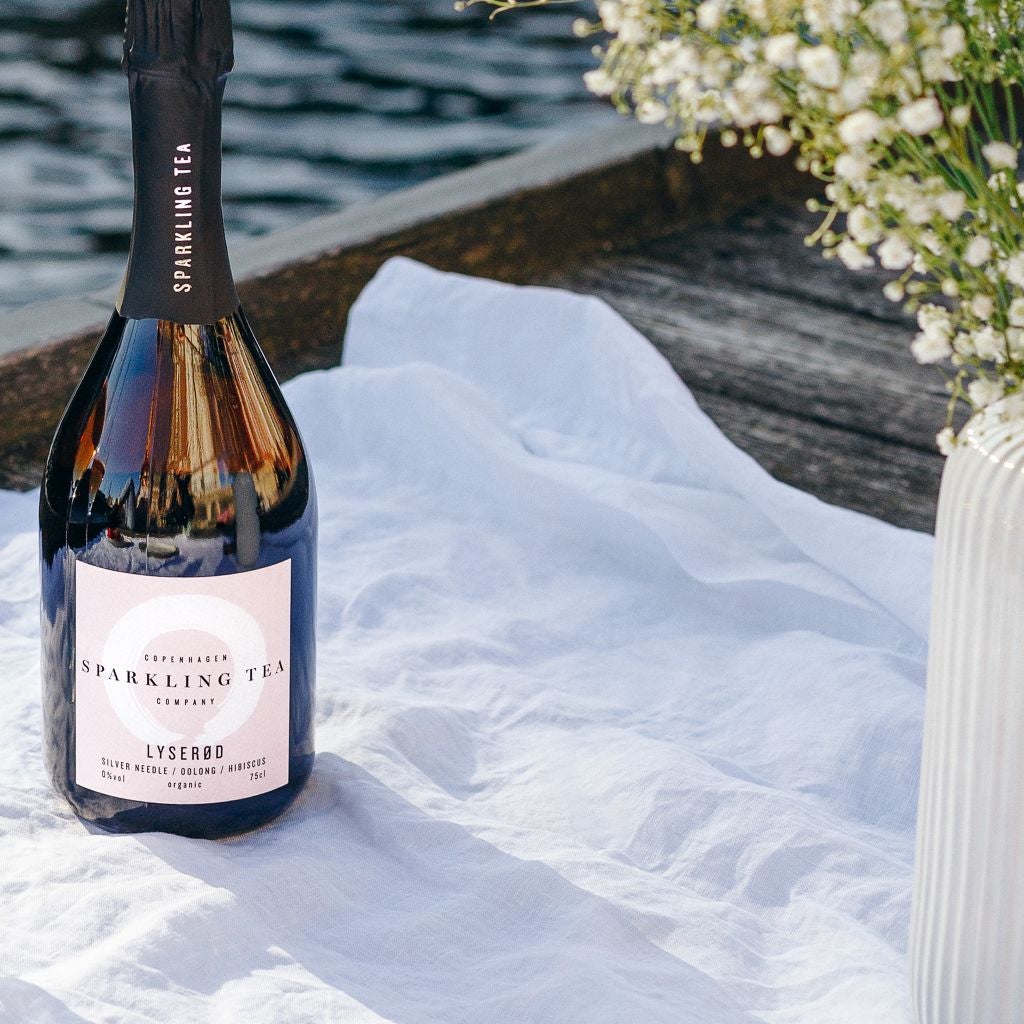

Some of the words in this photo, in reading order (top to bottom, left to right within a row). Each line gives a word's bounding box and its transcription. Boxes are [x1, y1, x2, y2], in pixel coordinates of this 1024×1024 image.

[173, 143, 192, 177] TEA
[173, 186, 192, 293] SPARKLING
[144, 654, 228, 663] COPENHAGEN
[81, 659, 231, 688] SPARKLING
[245, 660, 285, 681] TEA
[156, 697, 215, 706] COMPANY
[146, 744, 224, 761] LYSERØD
[101, 757, 131, 771] SILVER
[134, 763, 168, 775] NEEDLE
[180, 766, 216, 775] OOLONG
[228, 757, 267, 773] HIBISCUS
[167, 780, 202, 790] organic
[249, 769, 266, 781] 75cl
